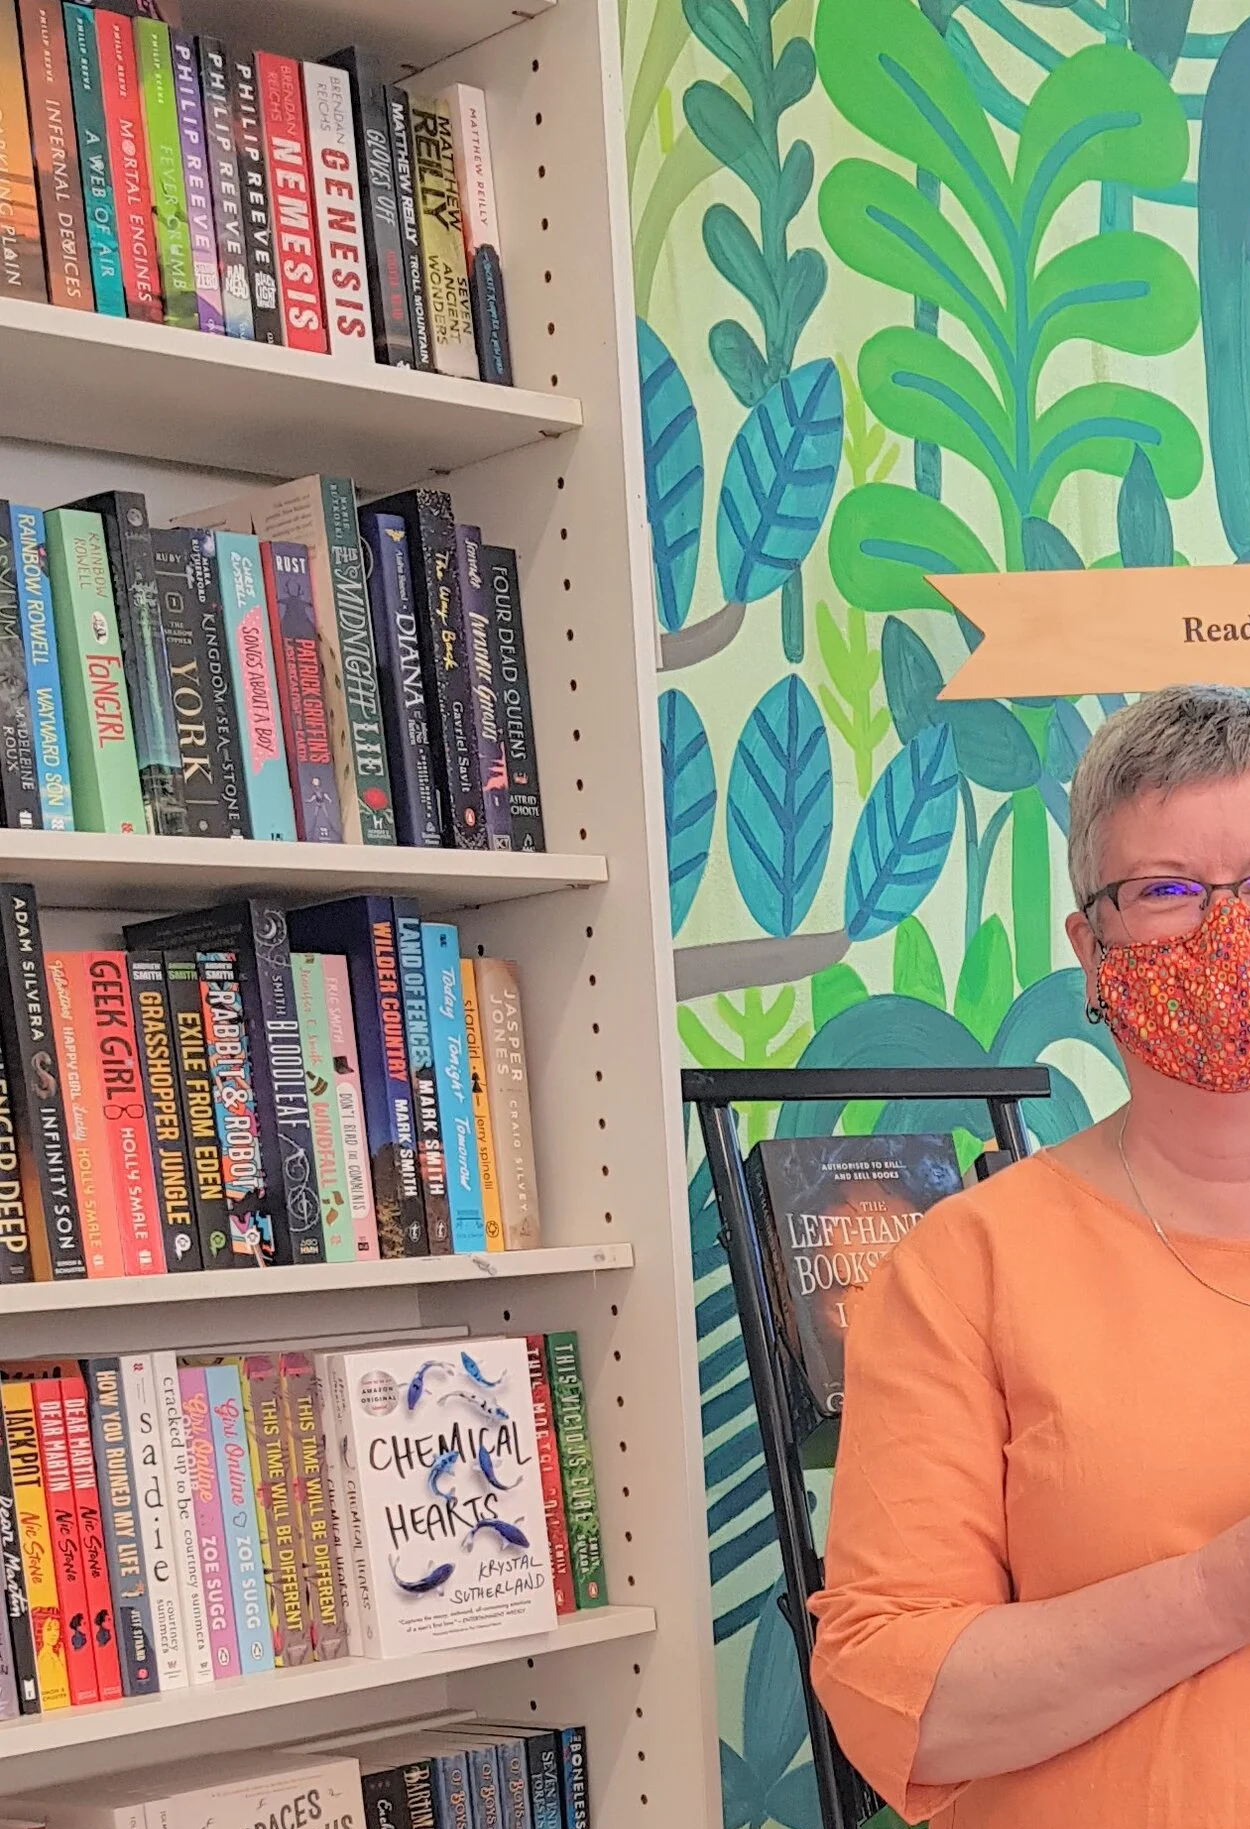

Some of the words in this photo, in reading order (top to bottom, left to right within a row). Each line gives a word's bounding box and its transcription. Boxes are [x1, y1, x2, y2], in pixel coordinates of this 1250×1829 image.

[236, 64, 258, 159] PHILIP
[248, 171, 269, 263] REEVE
[412, 109, 449, 231] REILLY
[438, 117, 461, 231] MATTHEW
[272, 136, 318, 330] NEMESIS
[321, 148, 365, 337] GENESIS
[18, 513, 39, 595] RAINBOW
[492, 565, 512, 617] FOUR
[26, 592, 48, 665] ROWELL
[498, 625, 517, 683] DEAD
[34, 688, 56, 767] WAYWARD
[172, 660, 213, 784] YORK
[504, 689, 526, 760] QUEENS
[45, 769, 64, 805] SON
[12, 897, 33, 952] ADAM
[22, 960, 43, 1041] SILVERA
[89, 960, 127, 1027] GEEK
[177, 1012, 204, 1071] EXILE
[209, 990, 245, 1080] RABBIT
[222, 1085, 248, 1109] &
[267, 1020, 309, 1129] BLOODLEAF
[186, 1078, 213, 1140] FROM
[40, 1107, 68, 1200] INFINITY
[195, 1147, 222, 1200] EDEN
[225, 1116, 260, 1189] ROBOT
[53, 1203, 75, 1250] SON
[860, 1200, 887, 1213] THE
[96, 1370, 118, 1407] HOW
[101, 1408, 123, 1445] YOU
[369, 1421, 533, 1480] CHEMICAL
[106, 1447, 131, 1508] RUINED
[112, 1511, 136, 1539] MY
[385, 1492, 501, 1550] HEARTS
[117, 1542, 139, 1577] LIFE
[450, 1571, 546, 1605] SUTHERLAND
[478, 1553, 544, 1580] KRYSTAL
